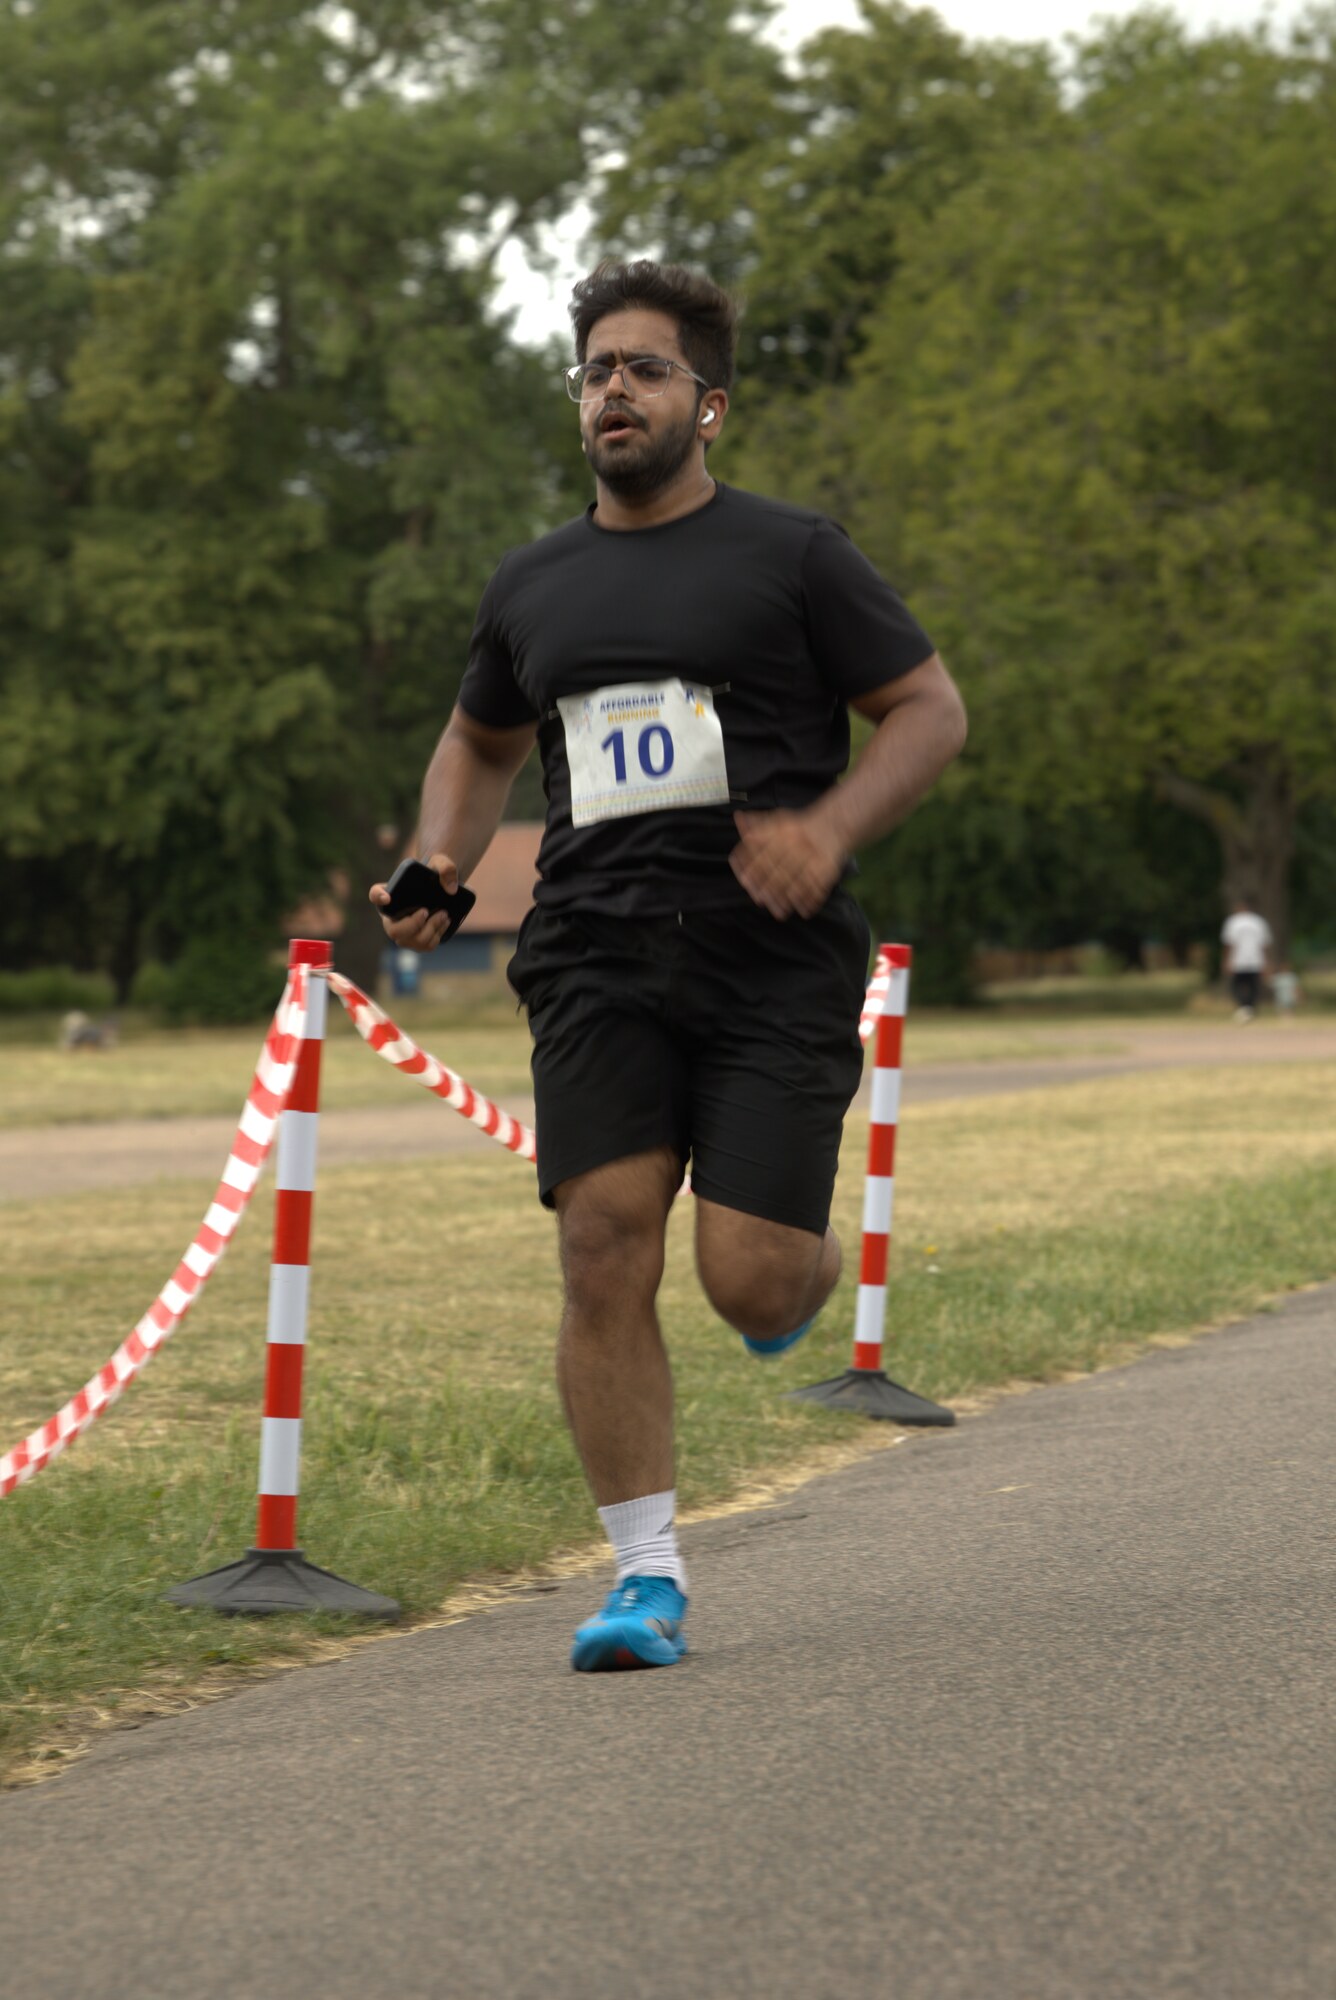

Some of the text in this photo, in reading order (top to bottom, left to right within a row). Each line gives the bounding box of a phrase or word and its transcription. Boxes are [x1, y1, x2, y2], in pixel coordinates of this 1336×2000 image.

[600, 692, 665, 711] AFFORDABLE
[607, 708, 660, 724] RUNNING
[601, 723, 675, 785] 10
